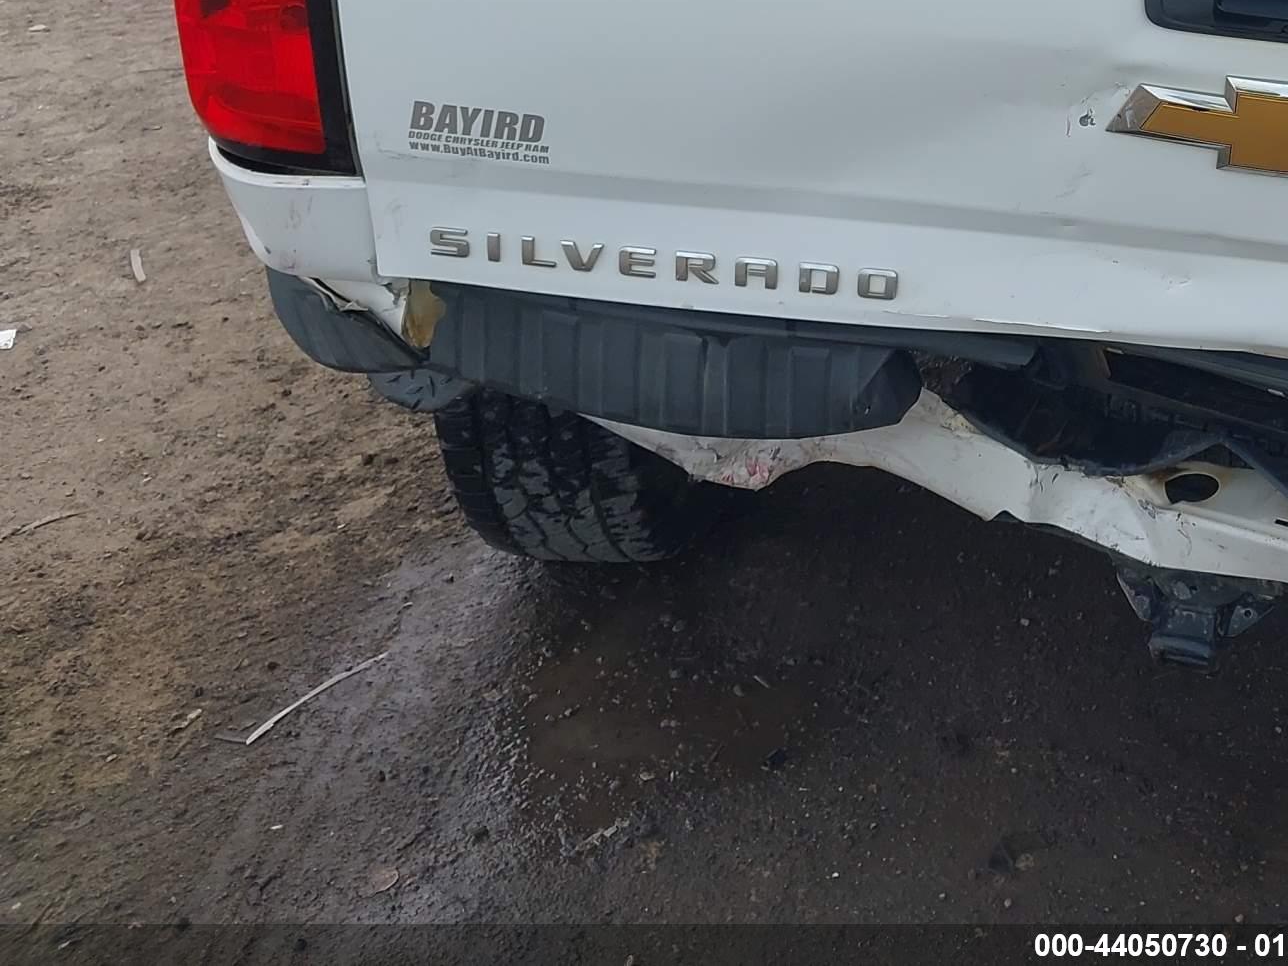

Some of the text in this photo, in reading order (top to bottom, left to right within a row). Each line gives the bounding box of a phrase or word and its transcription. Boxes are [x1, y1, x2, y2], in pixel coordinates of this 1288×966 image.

[410, 100, 545, 143] BAYIRD
[408, 130, 550, 153] DODGE CHRYSLER JEEP RAM
[408, 141, 550, 165] www.BuyAtBayird.com
[430, 226, 900, 301] SILVERADO
